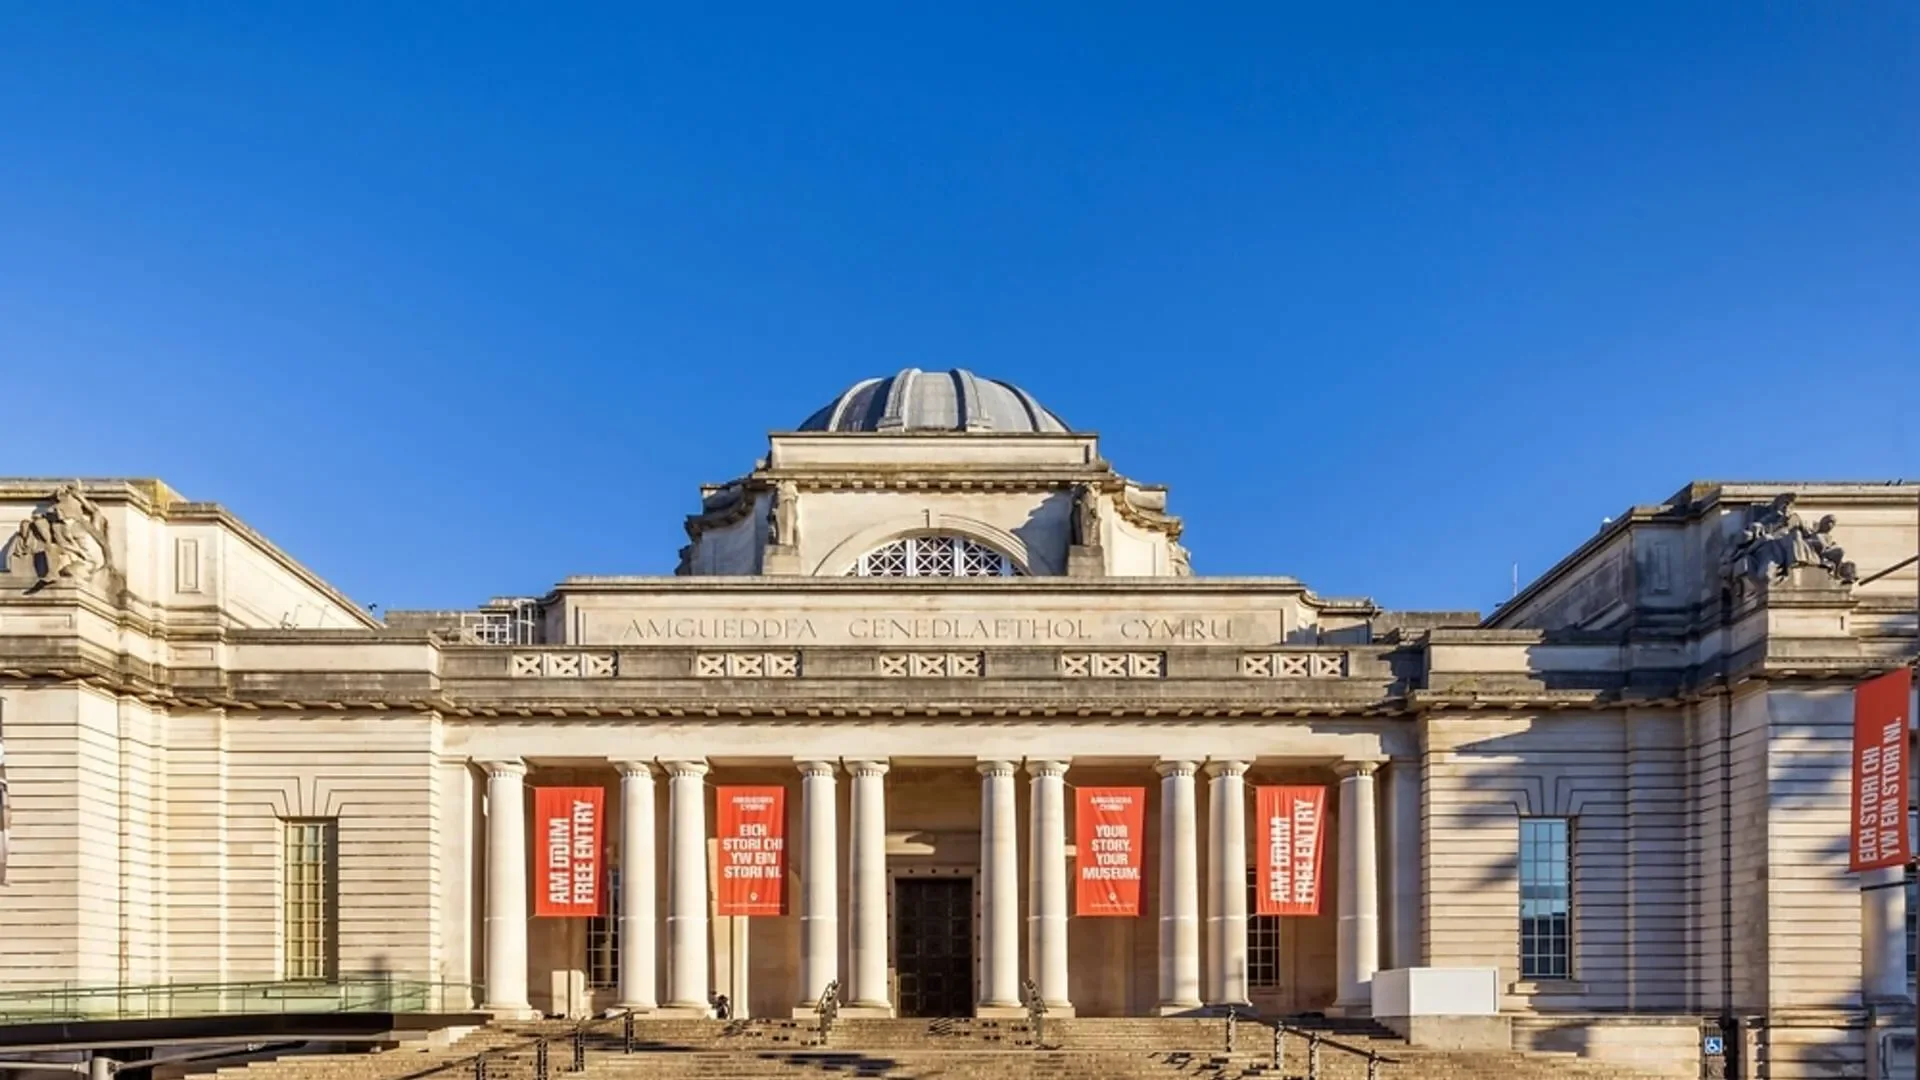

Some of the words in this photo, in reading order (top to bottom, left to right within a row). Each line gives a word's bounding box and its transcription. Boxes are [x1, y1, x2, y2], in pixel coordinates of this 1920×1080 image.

[624, 618, 817, 639] AMGUEDDFA
[848, 618, 1092, 639] GENEDLAETHOL
[1120, 618, 1232, 639] CYMRU
[1882, 716, 1902, 745] NI.
[1861, 746, 1881, 775] CHI
[1881, 744, 1901, 796] STORI
[1860, 775, 1880, 826] STORI
[1880, 797, 1900, 828] EIN
[548, 817, 570, 868] DDIM
[573, 800, 594, 859] ENTRY
[739, 823, 767, 837] EICH
[1095, 824, 1129, 838] YOUR
[1270, 816, 1290, 867] DDIM
[1293, 799, 1314, 858] ENTRY
[723, 837, 761, 851] STORI
[763, 837, 783, 851] CHI
[731, 851, 753, 865] YW
[754, 851, 777, 865] EIN
[1091, 838, 1132, 852] STORY.
[1095, 852, 1129, 866] YOUR
[1859, 827, 1878, 863] EICH
[1879, 830, 1900, 860] YW
[573, 862, 594, 904] FREE
[723, 865, 763, 879] STORI
[1082, 866, 1141, 880] MUSEUM.
[1270, 871, 1290, 903] AM
[1294, 860, 1315, 904] FREE
[548, 871, 570, 904] AM
